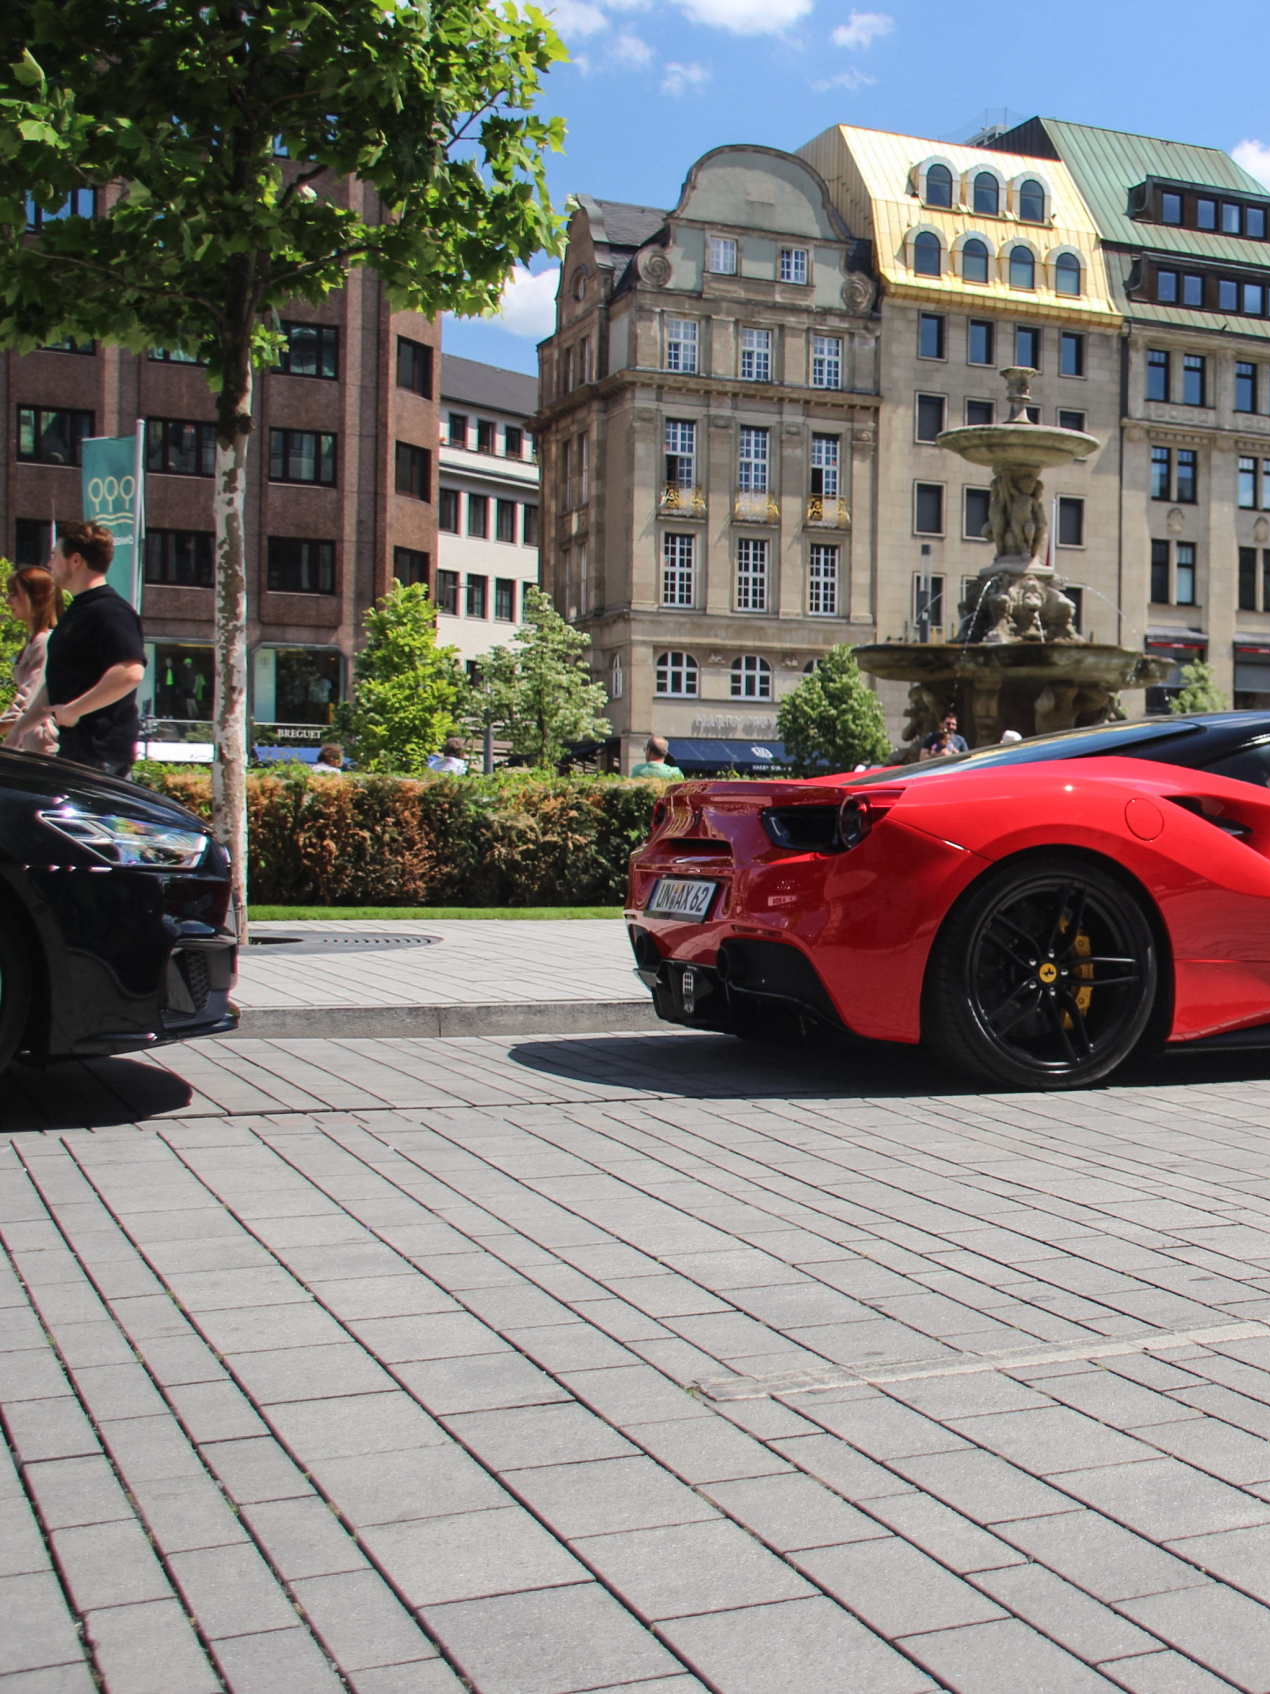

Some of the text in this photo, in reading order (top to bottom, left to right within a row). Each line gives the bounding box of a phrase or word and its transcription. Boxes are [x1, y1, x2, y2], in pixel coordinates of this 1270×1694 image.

[695, 713, 743, 728] HARRY
[277, 728, 323, 739] BREGUET
[655, 883, 710, 913] UN AX 62
